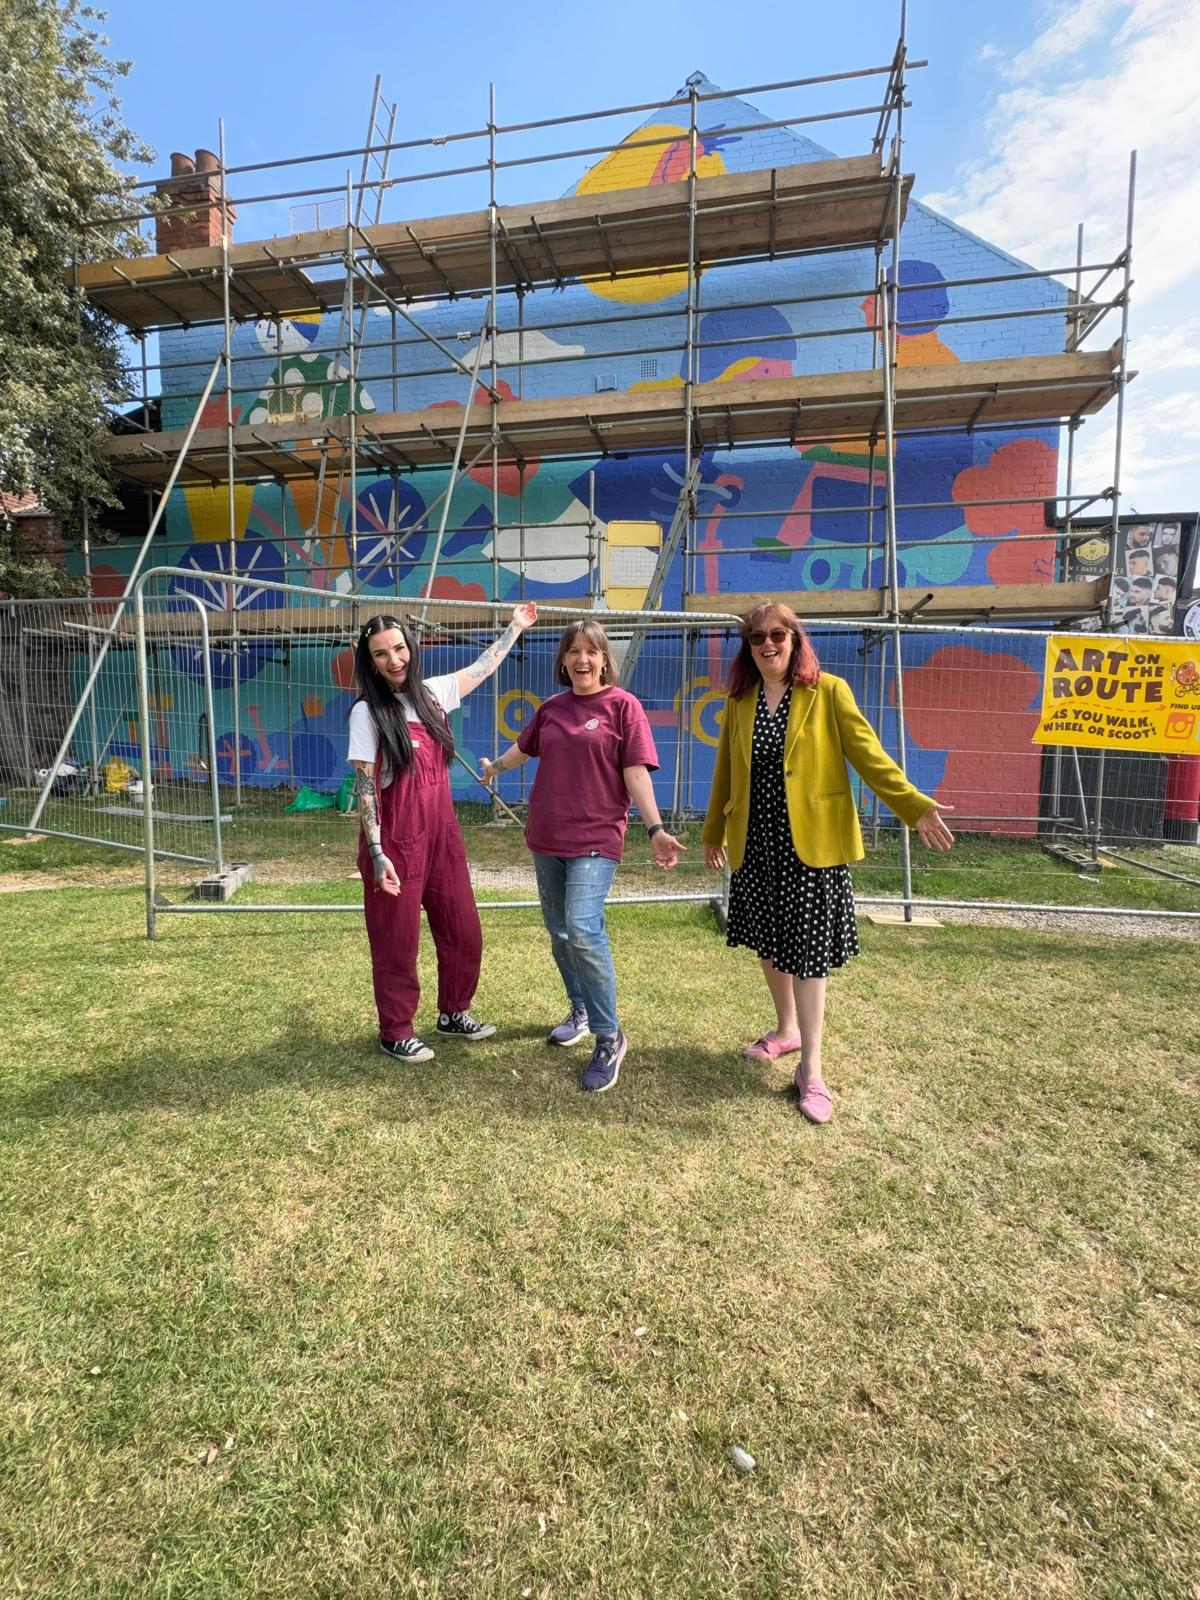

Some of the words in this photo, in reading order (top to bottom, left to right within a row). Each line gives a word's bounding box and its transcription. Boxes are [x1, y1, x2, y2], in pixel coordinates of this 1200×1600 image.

[1053, 648, 1129, 676] ART
[1134, 653, 1161, 665] ON
[1127, 666, 1165, 678] THE
[1052, 675, 1163, 704] ROUTE
[1050, 708, 1068, 721] AS
[1072, 708, 1103, 723] YOU
[1043, 722, 1085, 733] WHEEL
[1087, 725, 1106, 737] OR
[1107, 727, 1157, 740] SCOOT!
